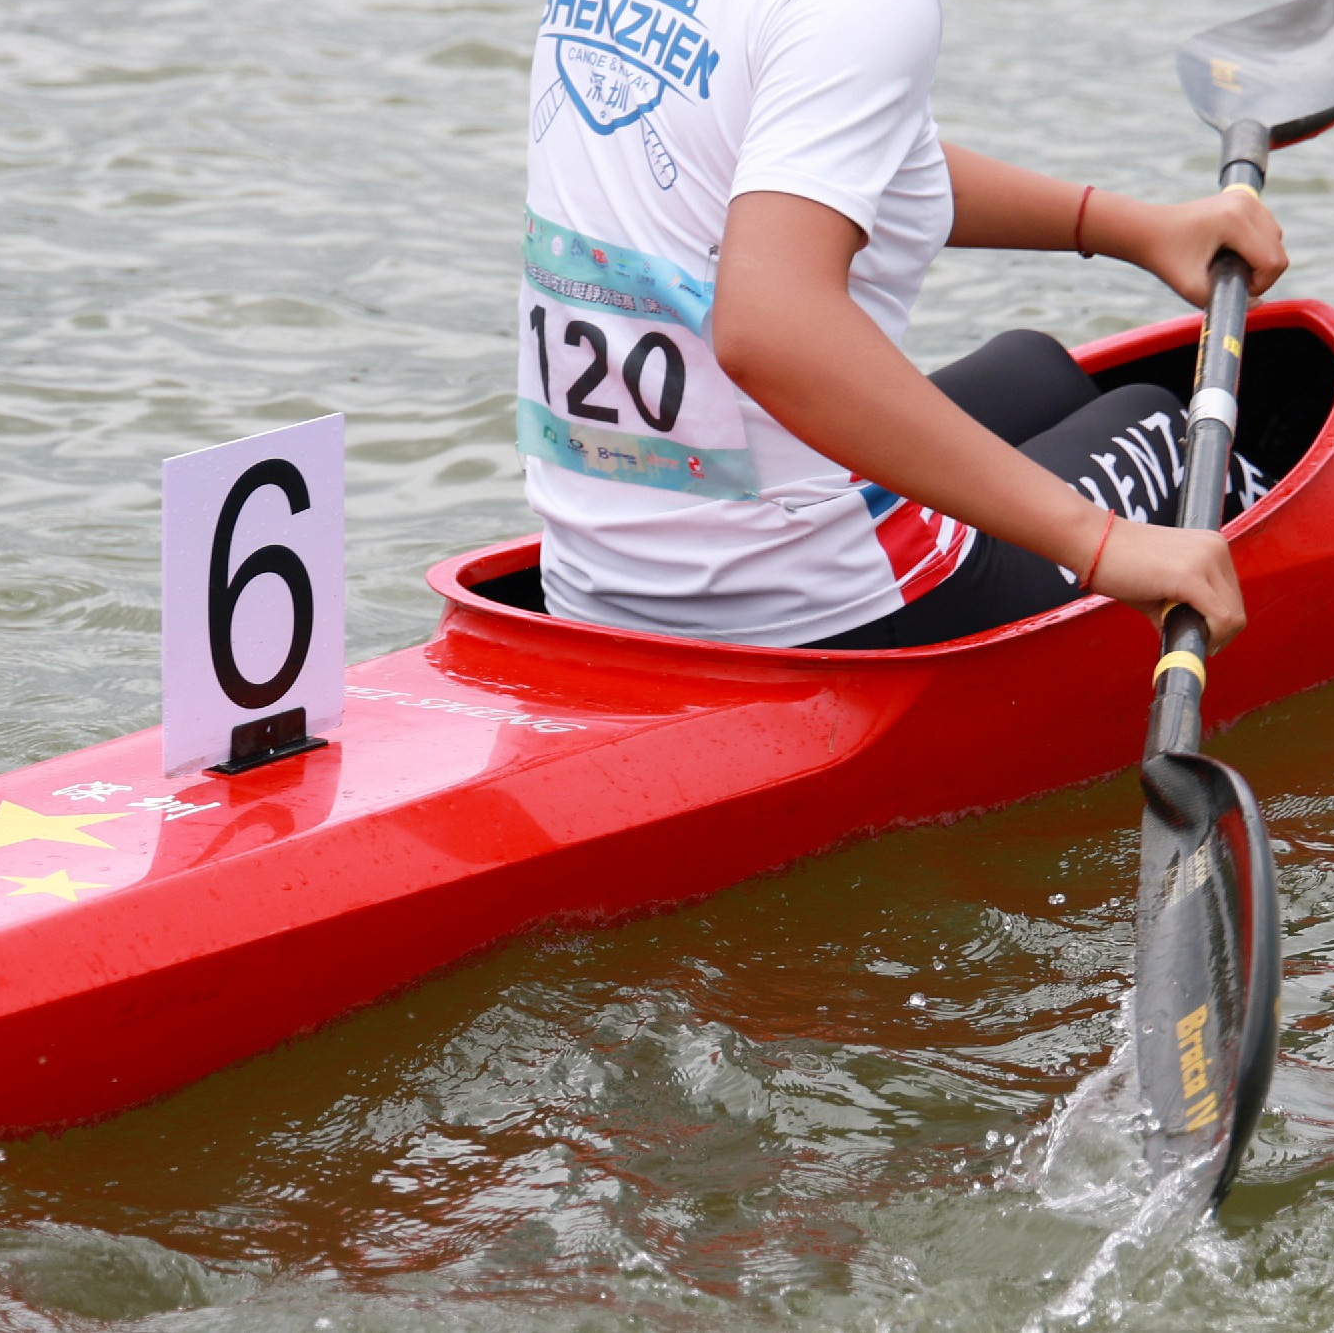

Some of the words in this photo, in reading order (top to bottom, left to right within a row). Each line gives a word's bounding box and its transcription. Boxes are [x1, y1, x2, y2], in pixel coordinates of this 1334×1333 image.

[586, 71, 630, 112] 深圳
[530, 304, 686, 433] 120
[208, 458, 313, 709] 6
